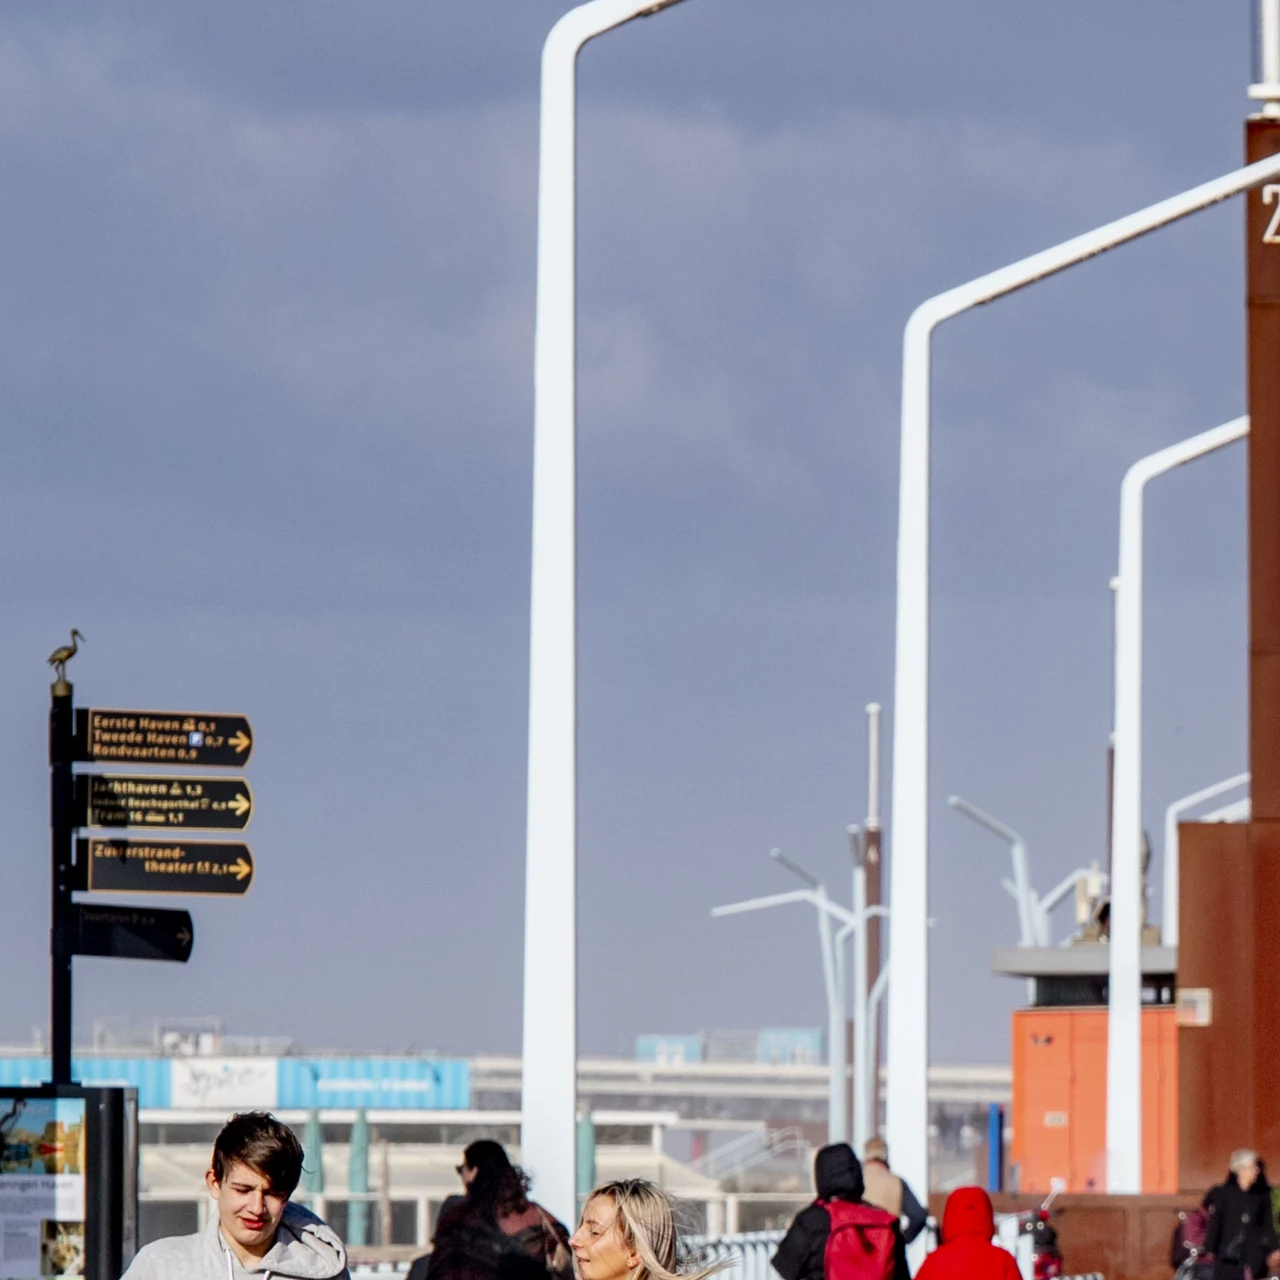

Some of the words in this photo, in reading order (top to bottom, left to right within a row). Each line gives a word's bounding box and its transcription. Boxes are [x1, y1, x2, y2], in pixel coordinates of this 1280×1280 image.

[93, 715, 137, 729] Eerste
[139, 717, 180, 731] Haven
[94, 729, 144, 743] Tweede
[147, 730, 188, 745] Haven
[93, 743, 176, 758] Rondvaarten
[129, 811, 143, 823] 16
[144, 861, 194, 874] theater
